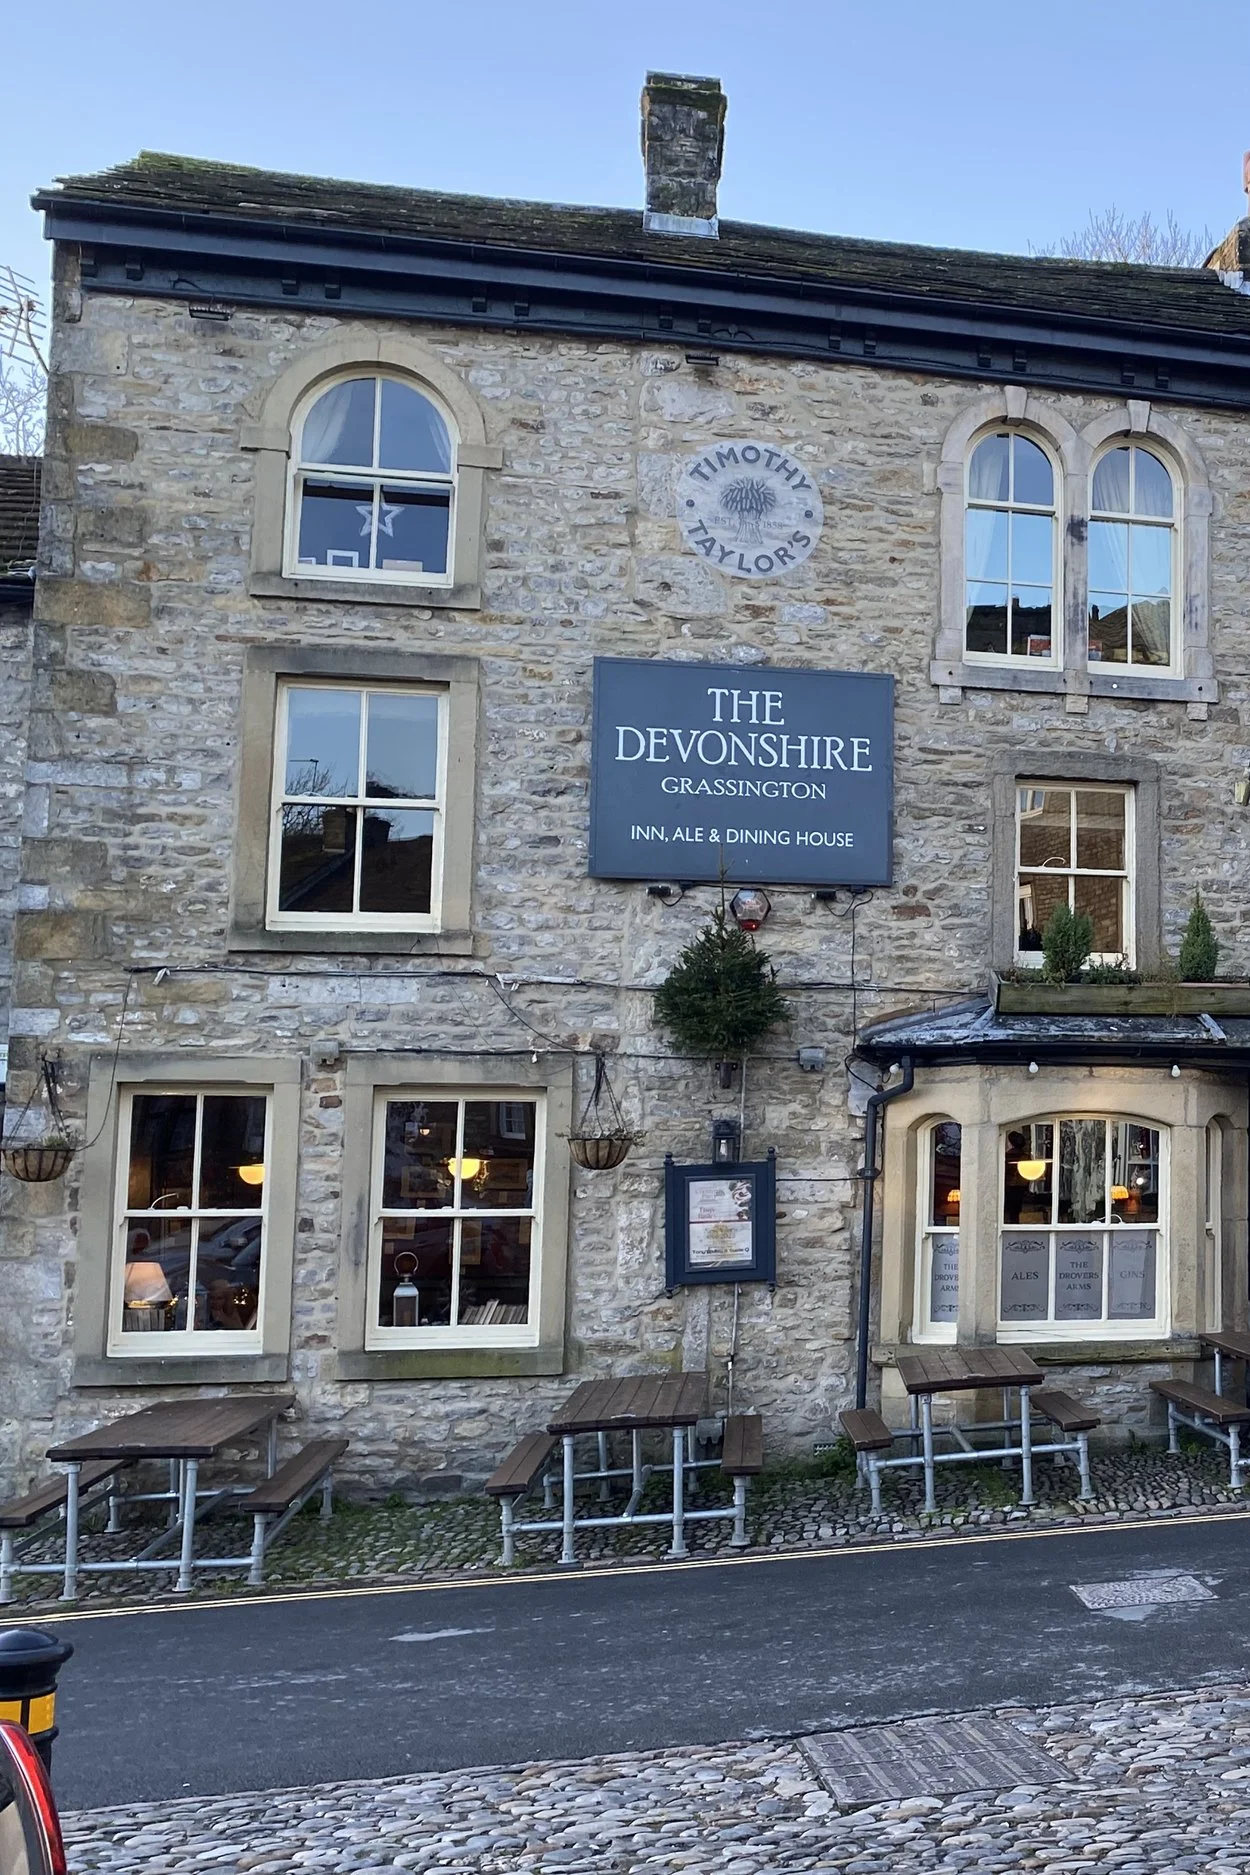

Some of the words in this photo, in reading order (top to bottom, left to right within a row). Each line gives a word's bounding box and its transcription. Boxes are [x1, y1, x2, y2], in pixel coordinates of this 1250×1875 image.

[689, 445, 812, 490] TIMOTHY
[687, 519, 811, 573] TAYLOR'S
[707, 688, 785, 725] THE
[615, 726, 873, 772] DEVONSHIRE
[661, 777, 826, 800] GRASSINGTON
[631, 825, 669, 843] INN,
[672, 827, 704, 843] ALE
[708, 829, 720, 843] &
[726, 829, 790, 846] DINING
[796, 831, 854, 847] HOUSE
[1011, 1271, 1039, 1280] ALES
[1059, 1272, 1100, 1280] DROVERS
[1069, 1261, 1089, 1269] THE
[1119, 1270, 1145, 1279] GINS
[1066, 1283, 1092, 1291] ARMS
